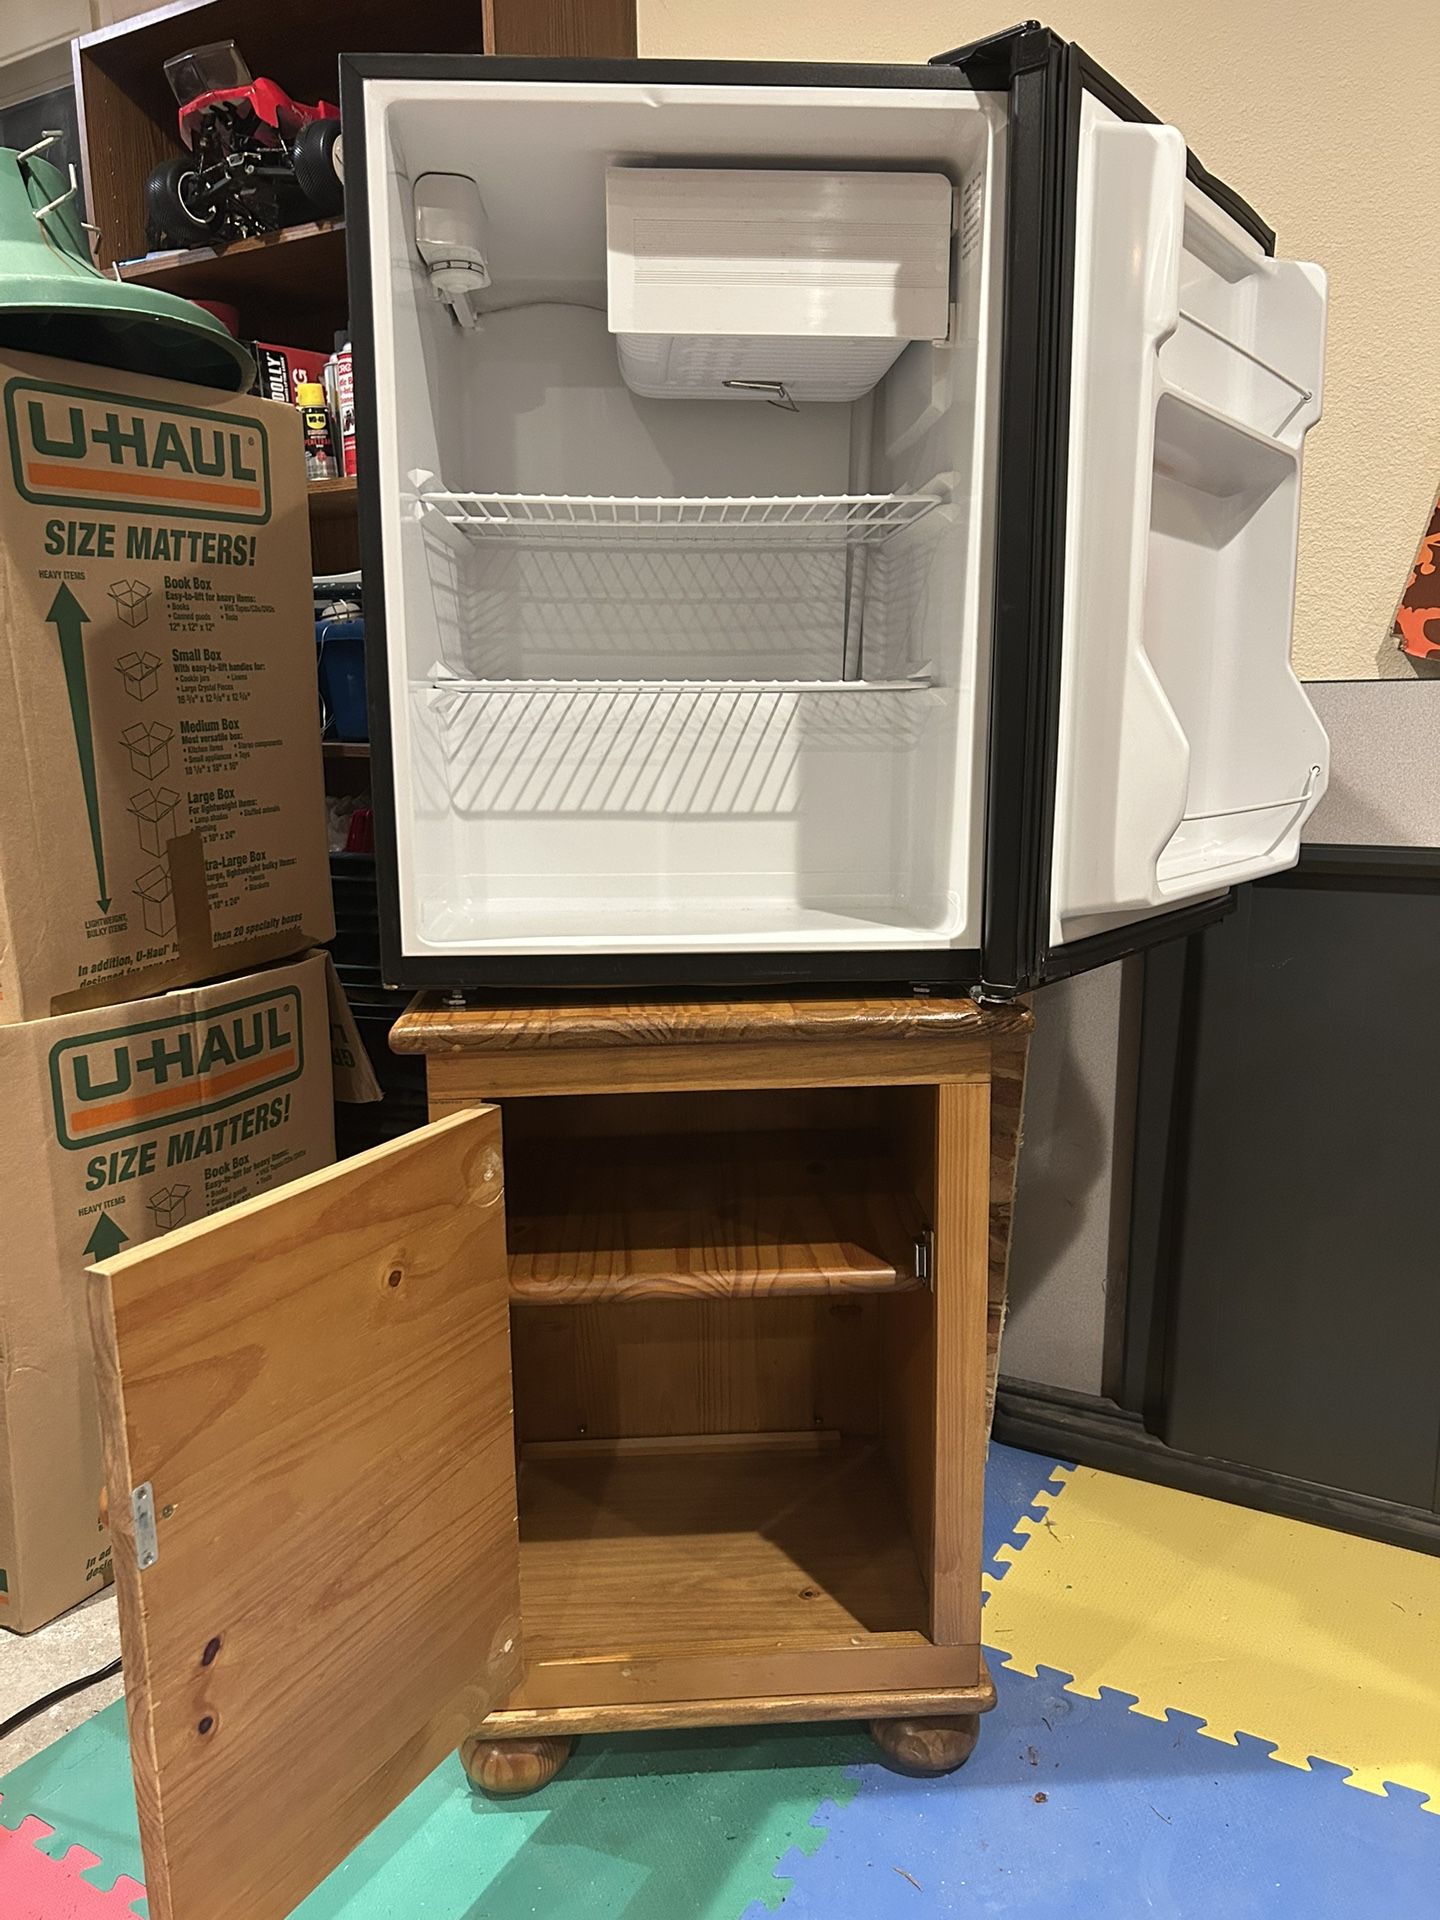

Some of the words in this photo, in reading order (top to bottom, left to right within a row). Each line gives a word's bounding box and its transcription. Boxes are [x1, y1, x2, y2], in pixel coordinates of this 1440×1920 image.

[266, 354, 286, 402] DOLLY
[28, 400, 257, 483] U-HAUL
[44, 519, 116, 558] SIZE
[126, 525, 257, 567] MATTERS!
[38, 569, 62, 580] HEAVY
[63, 571, 86, 581] ITEMS
[164, 575, 191, 590] Book
[193, 577, 212, 590] Box
[165, 591, 205, 602] Easy-to-lift
[206, 592, 215, 601] for
[172, 648, 201, 662] Small
[203, 648, 222, 661] Box
[173, 664, 191, 673] With
[192, 663, 228, 674] easy-to-lift
[229, 662, 253, 672] handles
[180, 719, 219, 734] Medium
[221, 718, 240, 731] Box
[182, 735, 199, 745] Most
[200, 733, 228, 743] versatile
[187, 791, 215, 804] Large
[217, 788, 235, 800] Box
[188, 806, 199, 815] For
[205, 854, 248, 871] tra-Large
[249, 850, 266, 862] Box
[84, 913, 128, 929] LIGHTWEIGHT,
[213, 930, 232, 942] than
[233, 925, 244, 937] 20
[245, 918, 281, 935] specialty
[281, 913, 303, 925] boxes
[86, 927, 107, 939] BULKY
[108, 922, 128, 934] ITEMS
[78, 965, 89, 977] In
[91, 955, 133, 975] addition,
[72, 1007, 291, 1101] U-HAUL
[85, 1140, 157, 1191] SIZE
[166, 1093, 292, 1168] MATTERS!
[204, 1162, 231, 1180] Book
[232, 1154, 250, 1169] Box
[78, 1202, 103, 1217] HEAVY
[103, 1196, 126, 1211] ITEMS
[86, 1557, 97, 1569] In
[86, 1559, 113, 1581] desig
